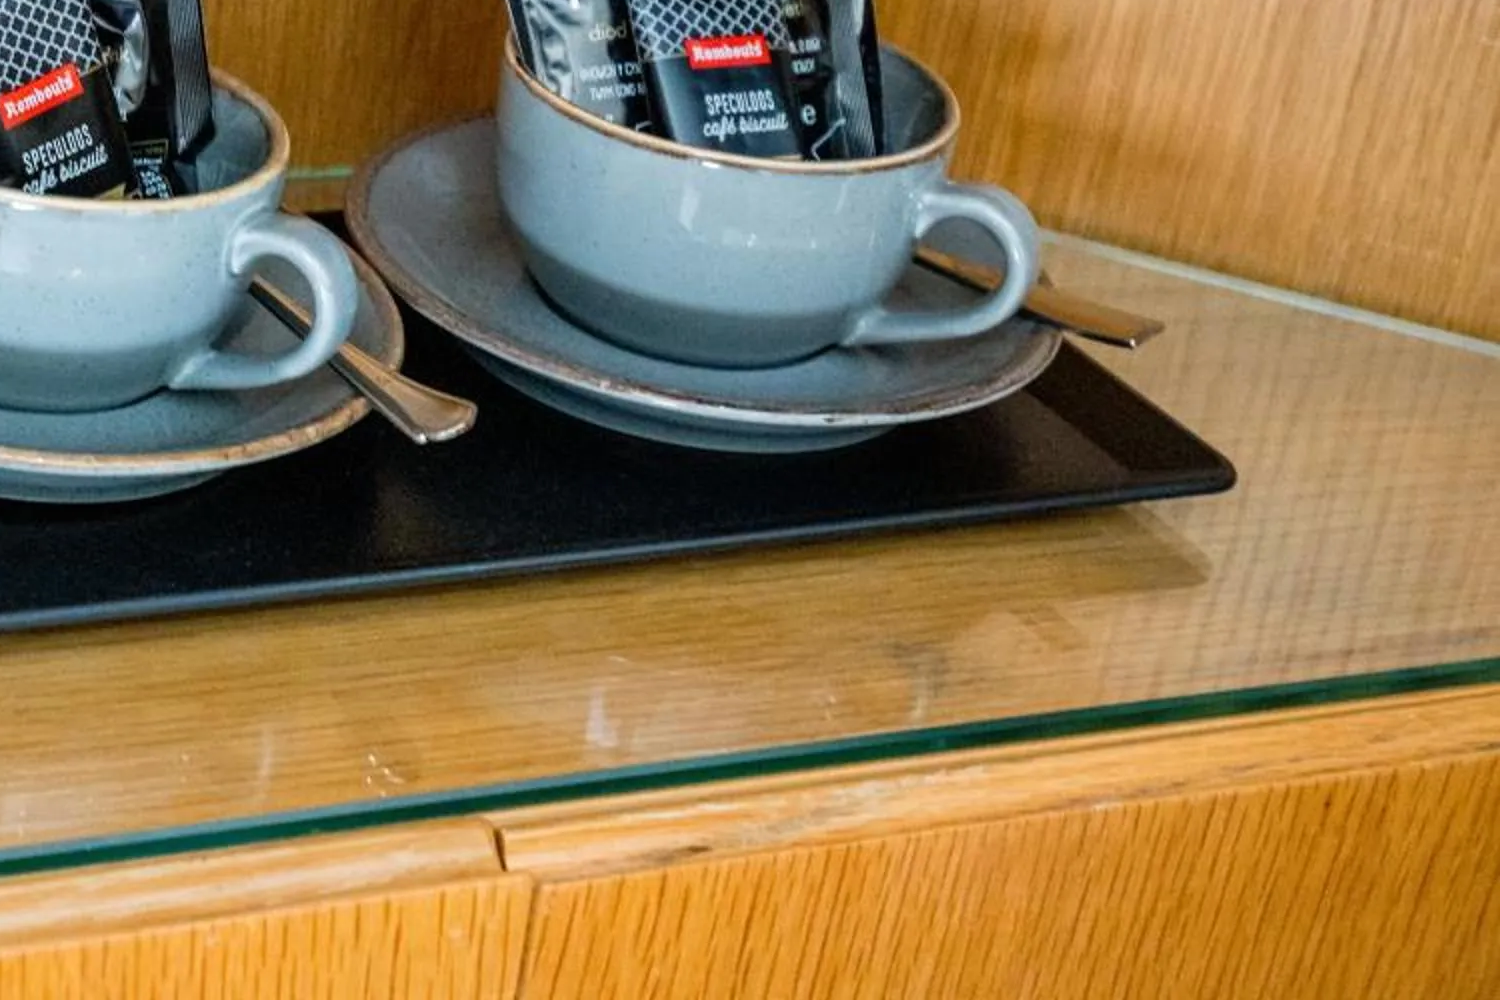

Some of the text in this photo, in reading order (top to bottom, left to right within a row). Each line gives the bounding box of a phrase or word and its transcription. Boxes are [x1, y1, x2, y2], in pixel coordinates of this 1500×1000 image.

[691, 42, 763, 62] Rombouts
[3, 70, 74, 118] Rombouts
[739, 111, 789, 132] biscuit
[21, 122, 94, 176] SPECULOOS
[58, 143, 110, 183] biscuit
